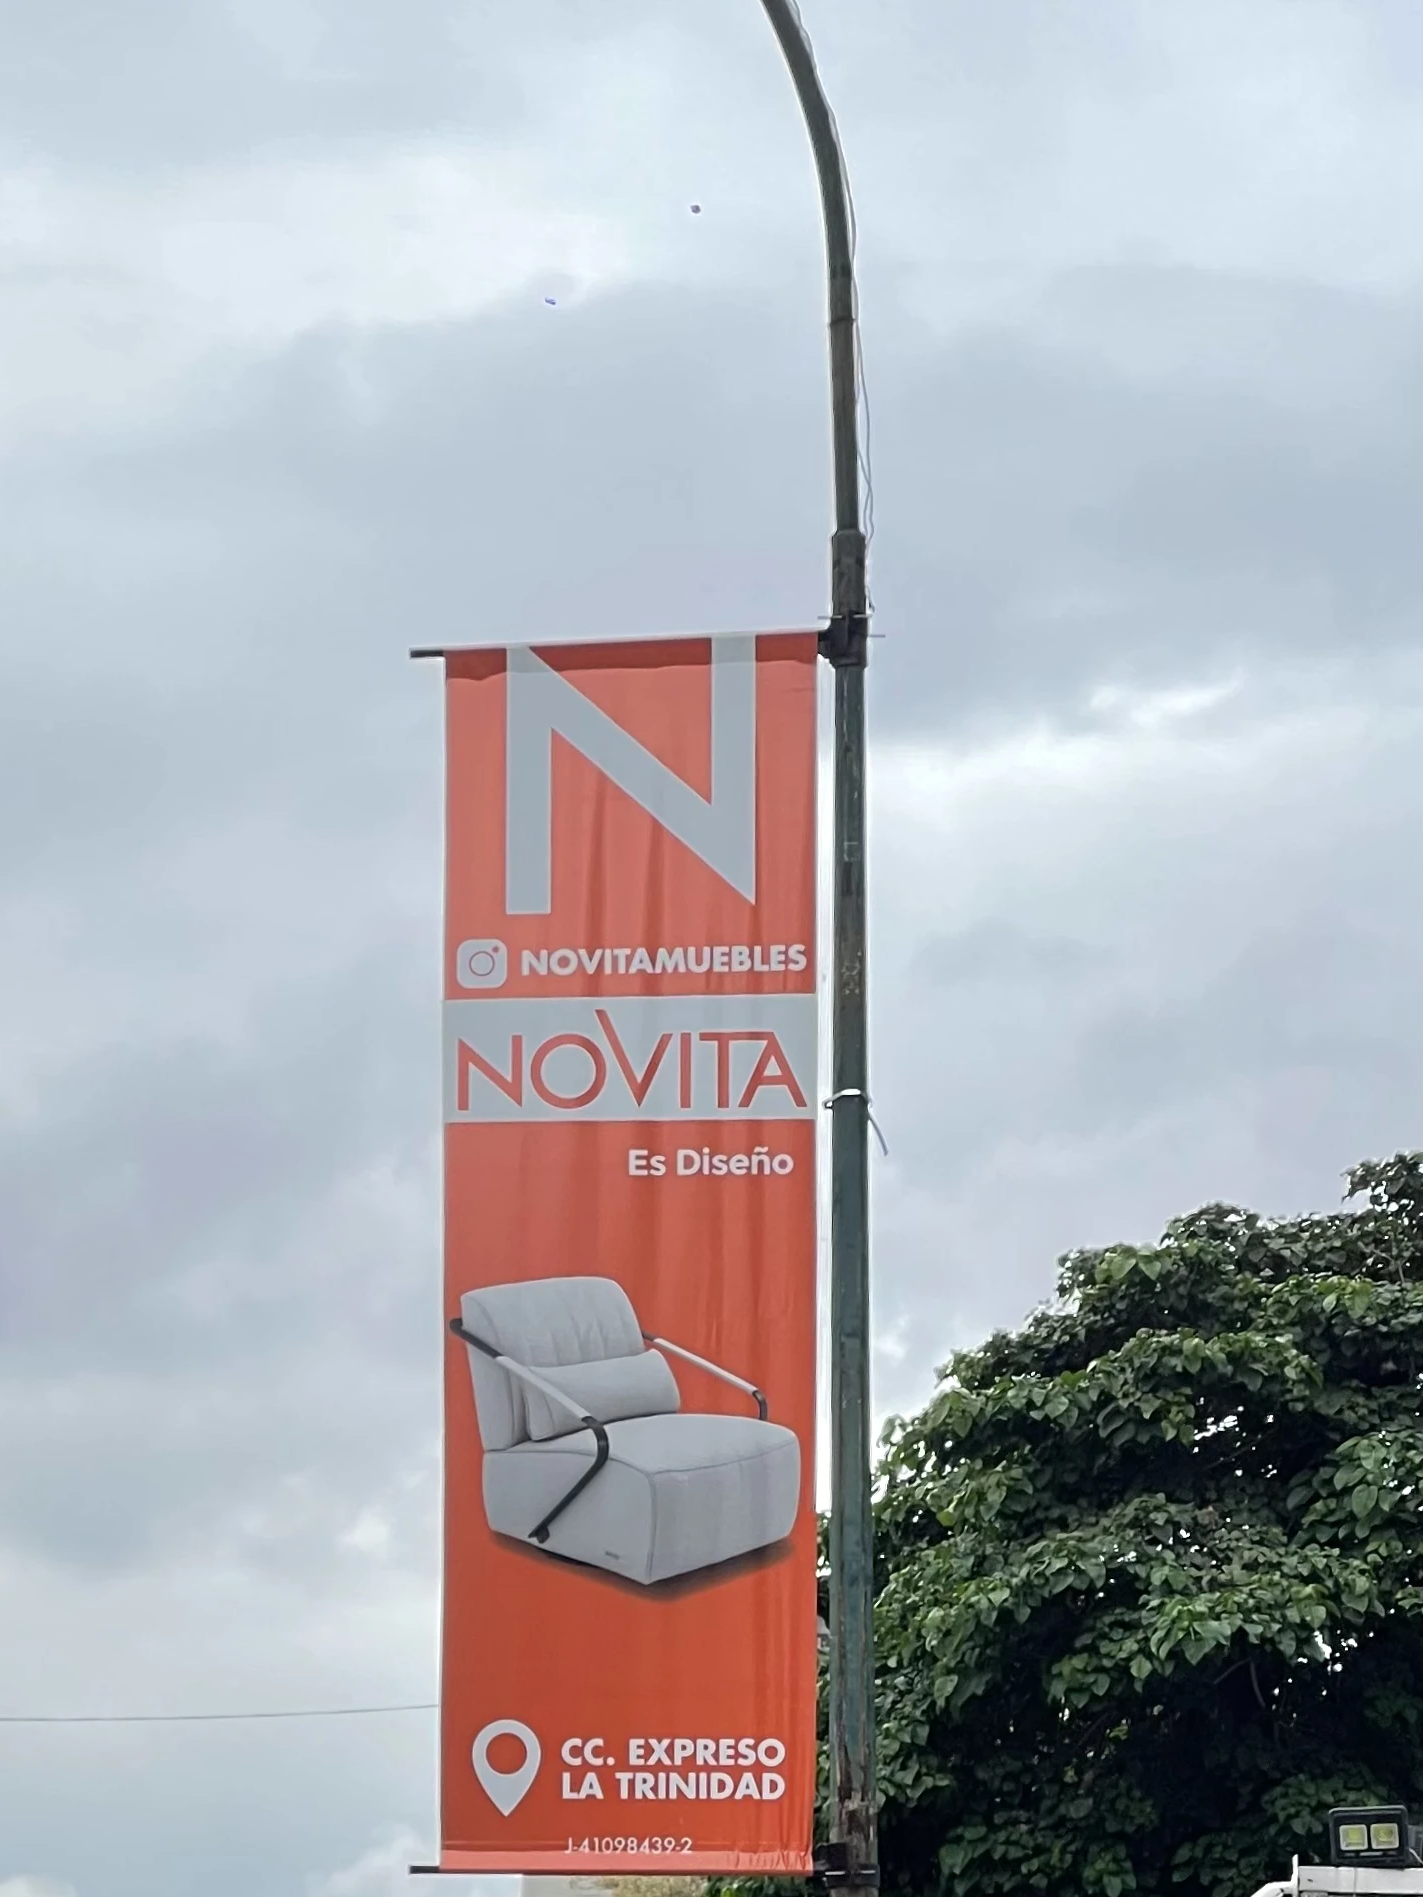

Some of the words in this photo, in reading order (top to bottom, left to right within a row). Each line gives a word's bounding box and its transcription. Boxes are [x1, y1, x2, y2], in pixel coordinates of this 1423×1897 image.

[506, 634, 756, 914] N
[521, 944, 808, 976] NOVITAMUEBLES
[457, 1009, 808, 1110] NOVITA
[628, 1149, 667, 1177] Es
[676, 1145, 794, 1177] Diseño
[561, 1738, 615, 1767] CC.
[629, 1738, 786, 1767] EXPRESO
[561, 1772, 604, 1800] LA
[615, 1772, 786, 1800] TRINIDAD
[564, 1837, 693, 1855] J-41098439-2
